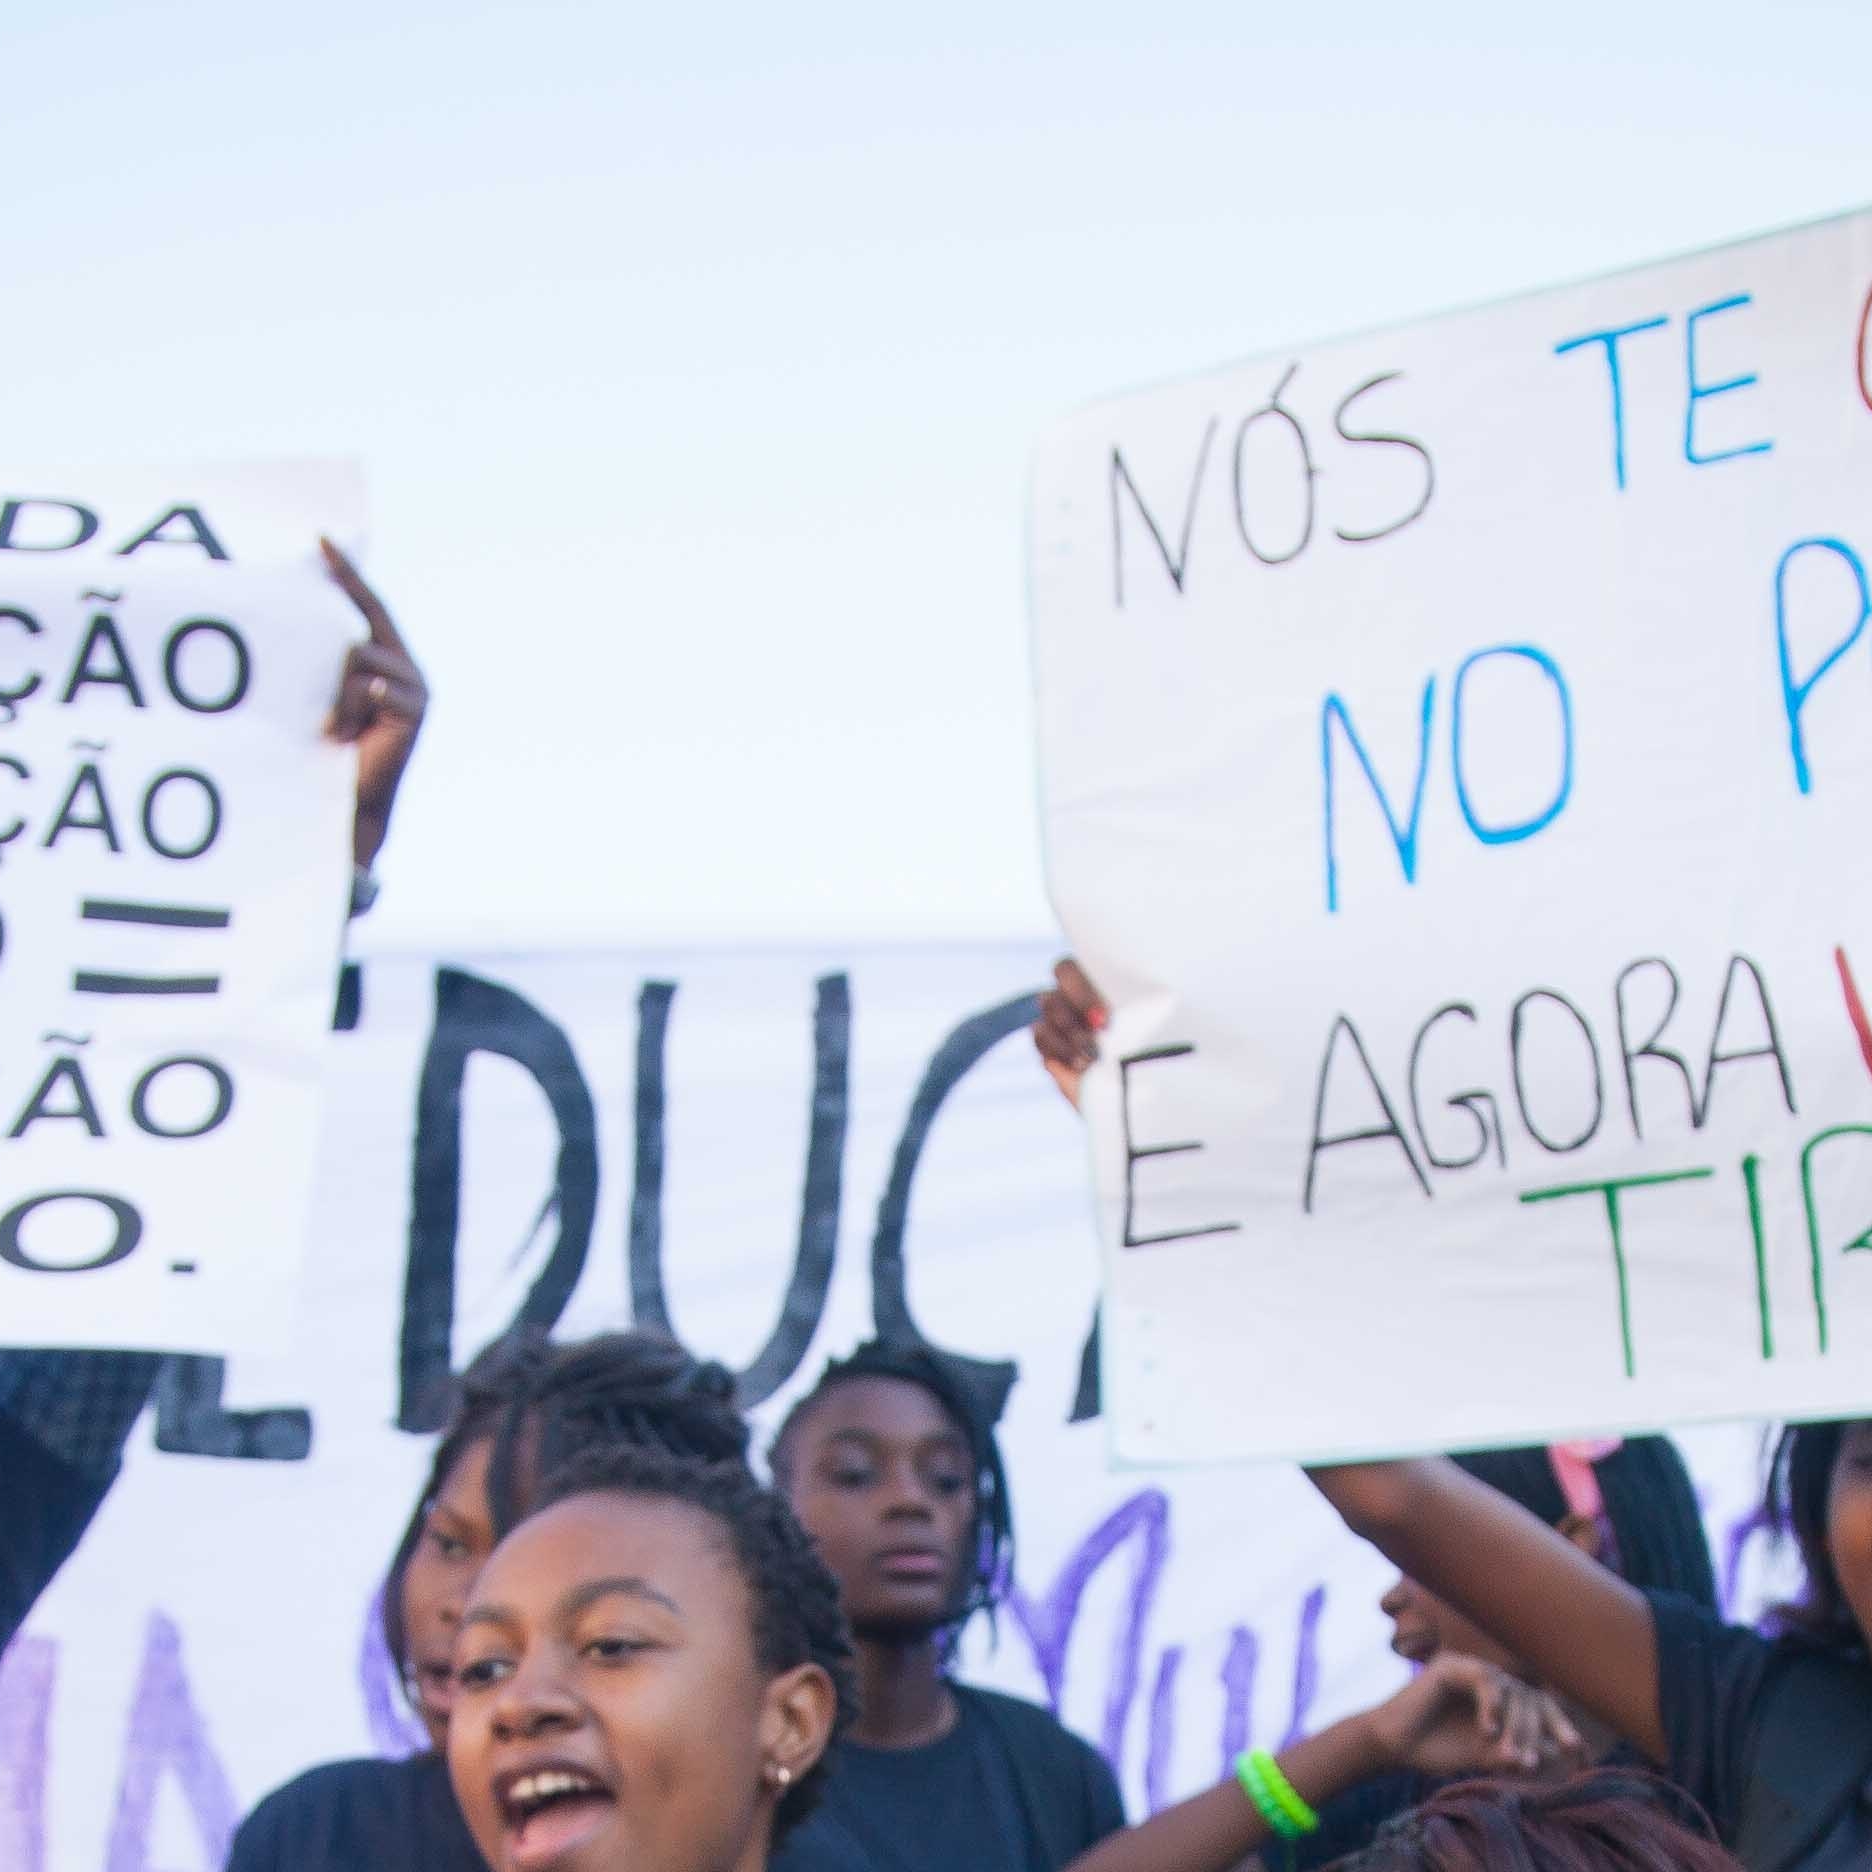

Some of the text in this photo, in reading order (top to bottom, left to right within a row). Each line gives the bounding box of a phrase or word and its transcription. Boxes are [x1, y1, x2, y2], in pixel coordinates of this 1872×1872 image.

[1109, 363, 1433, 608] NÓS
[1554, 292, 1773, 490] TE
[1320, 642, 1574, 912] NO
[1119, 1044, 1238, 1248] E
[1302, 954, 1799, 1214] AGORA
